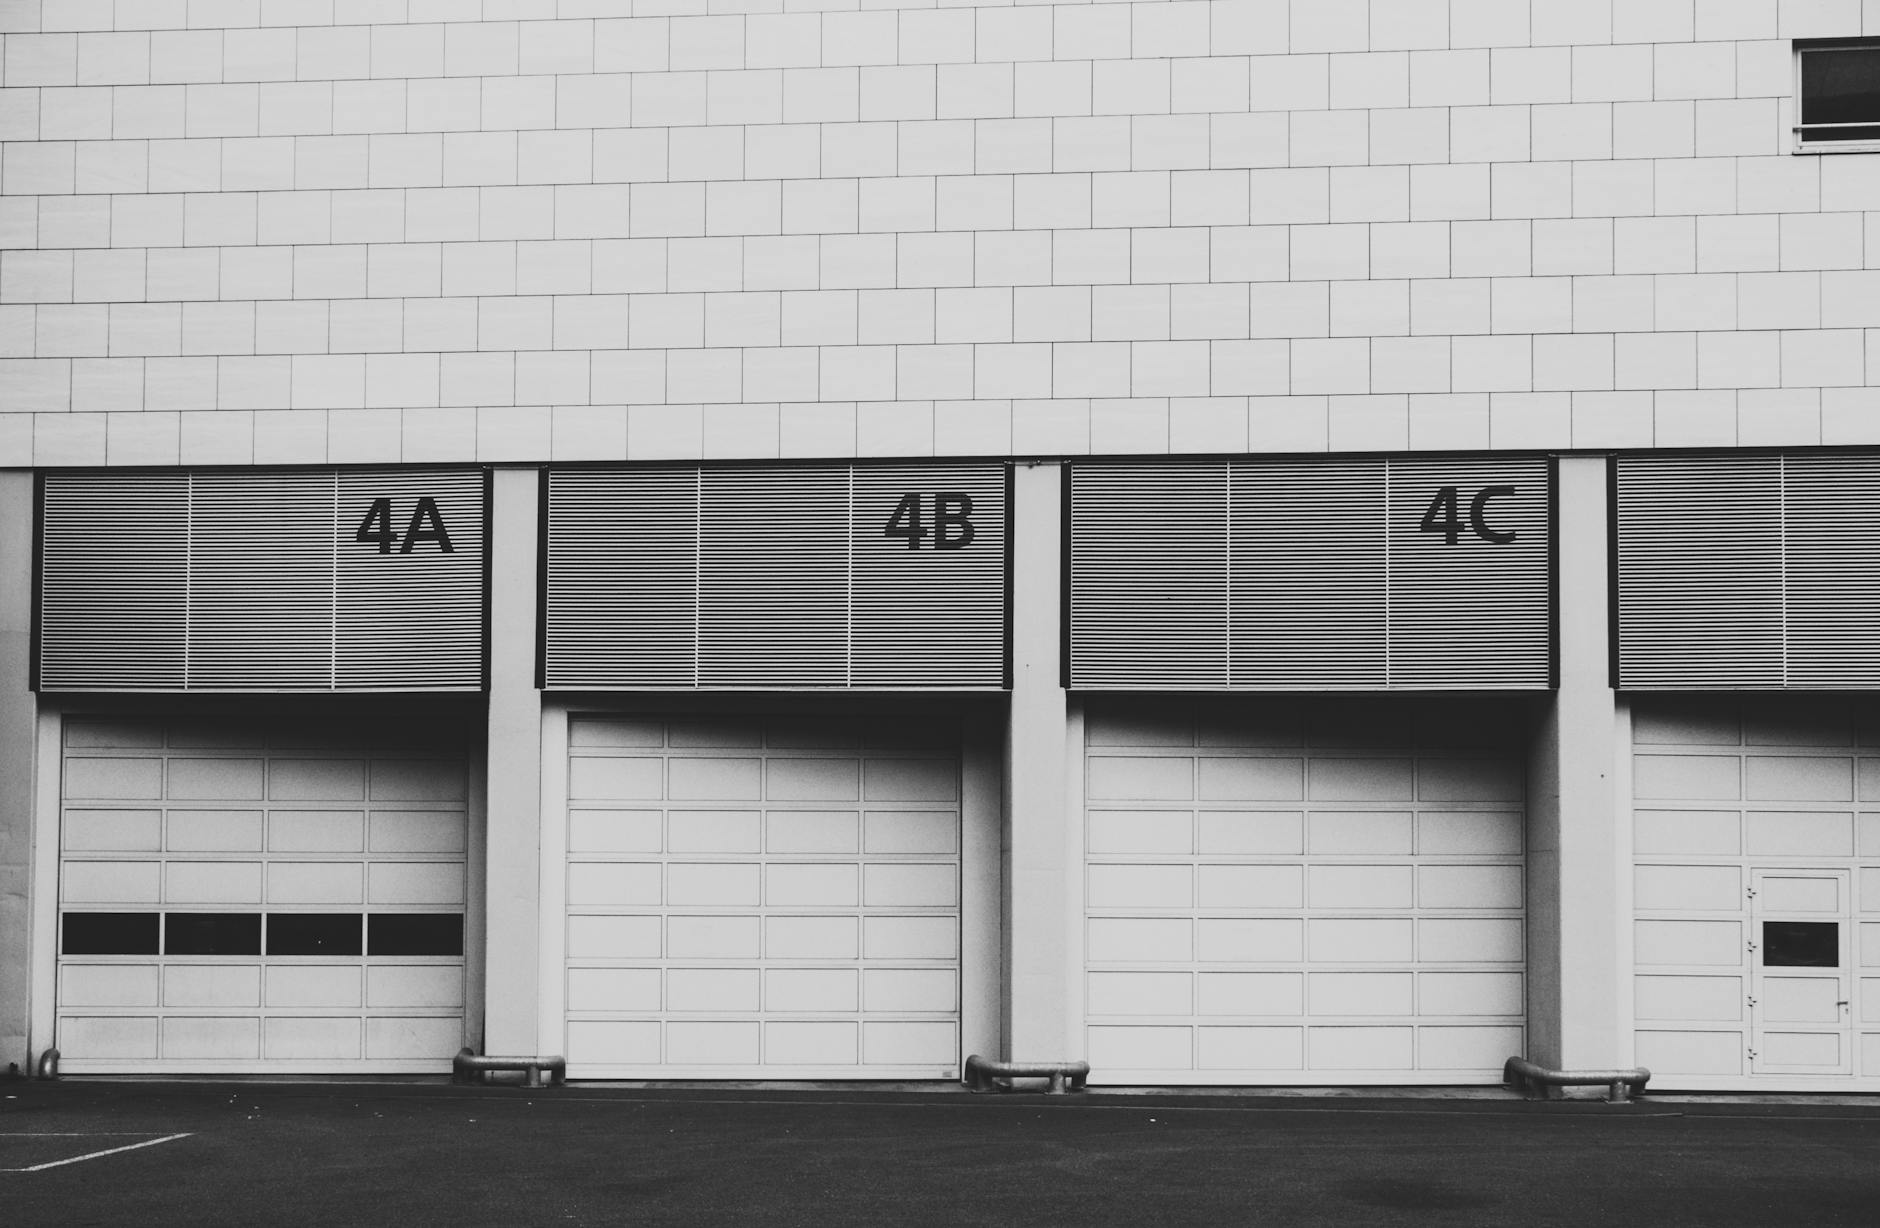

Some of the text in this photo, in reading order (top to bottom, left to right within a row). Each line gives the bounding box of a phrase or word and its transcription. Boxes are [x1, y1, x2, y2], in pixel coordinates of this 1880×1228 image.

[356, 498, 455, 554] 4A
[885, 493, 975, 549] 4B
[1420, 486, 1516, 545] 4C
